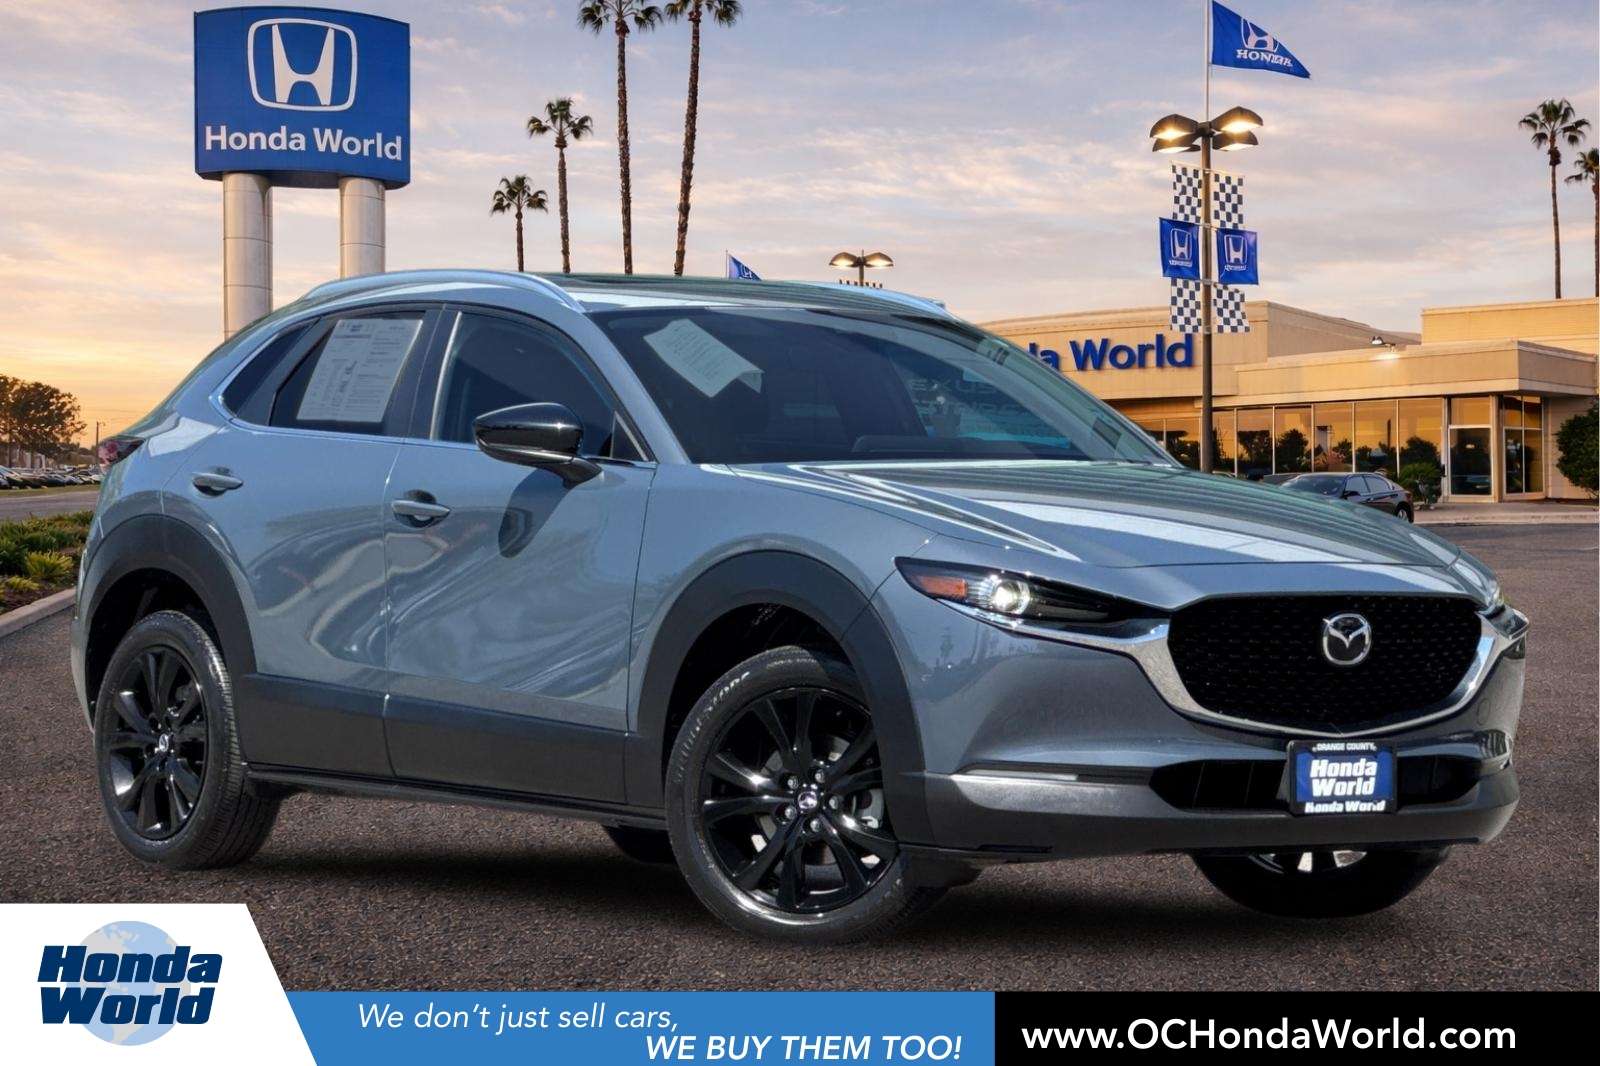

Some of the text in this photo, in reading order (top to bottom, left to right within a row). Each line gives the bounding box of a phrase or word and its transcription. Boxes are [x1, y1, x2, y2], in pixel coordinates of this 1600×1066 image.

[205, 125, 402, 161] Honda World
[1070, 333, 1194, 371] World
[1310, 758, 1378, 778] Honda
[1312, 777, 1376, 797] World
[1304, 801, 1344, 814] Honda
